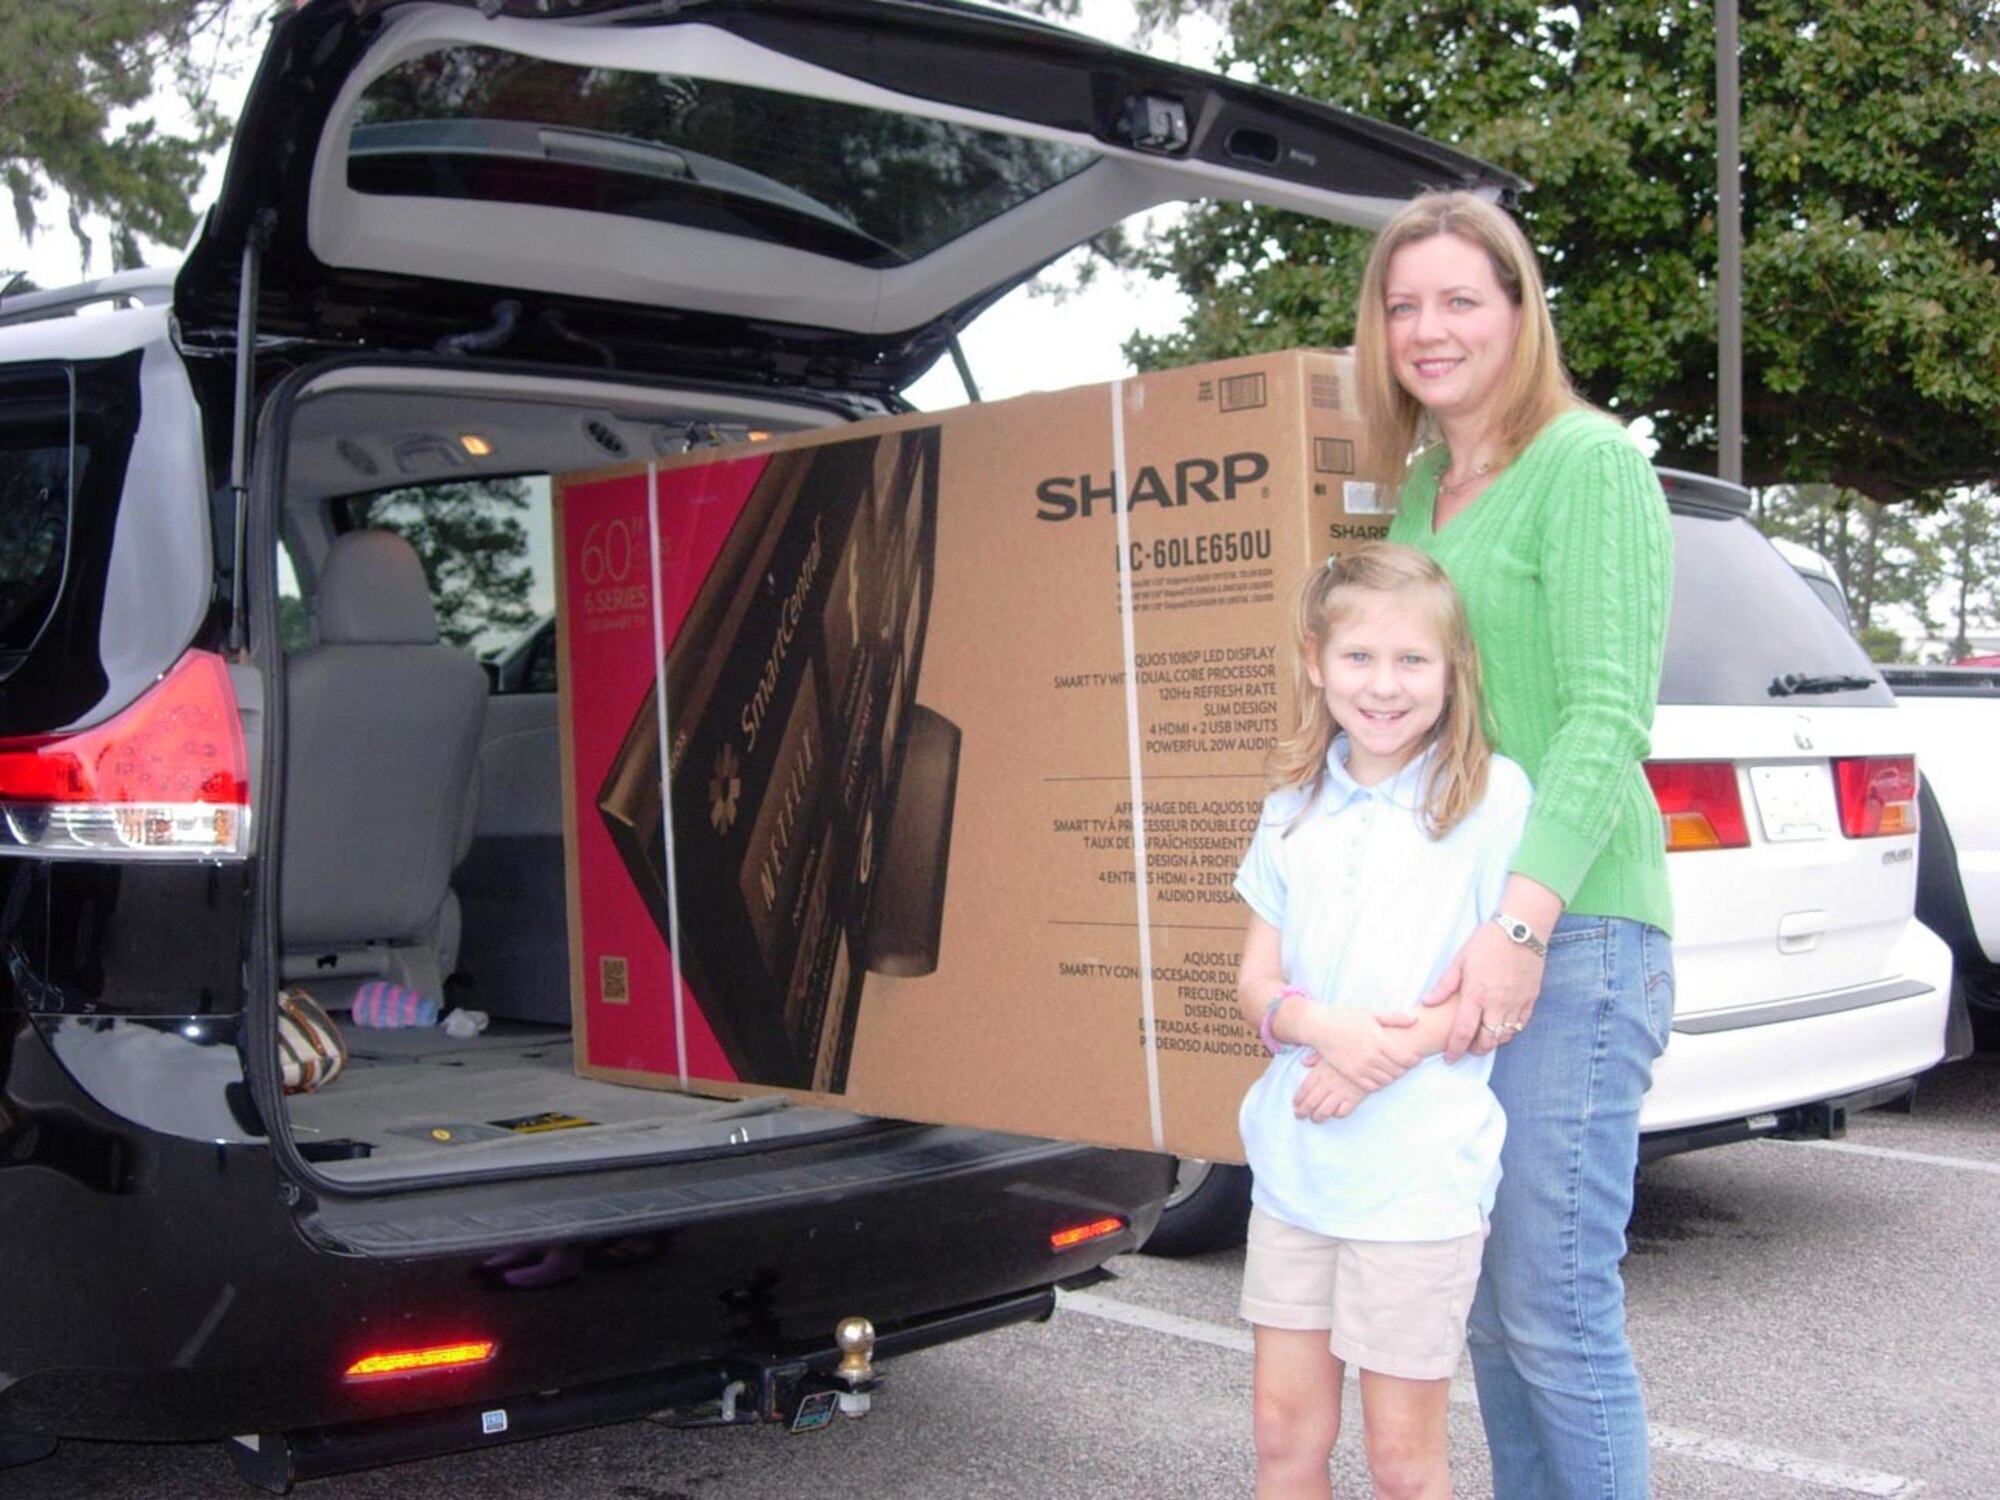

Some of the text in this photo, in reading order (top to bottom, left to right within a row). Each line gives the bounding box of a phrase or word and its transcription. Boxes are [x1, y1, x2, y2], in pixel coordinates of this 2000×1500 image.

[1036, 452, 1270, 521] SHARP
[1330, 523, 1389, 540] SHARP
[741, 514, 823, 752] SmartCentral
[1169, 650, 1201, 664] 1080P
[1203, 649, 1224, 663] LED
[1227, 646, 1276, 662] DISPLAY
[1054, 674, 1090, 688] SMART
[1093, 673, 1108, 687] TV
[1141, 669, 1172, 685] DUAL
[1174, 667, 1205, 682] CORE
[1208, 665, 1276, 680] PROCESSOR
[1159, 683, 1277, 700] 120Hz REFRESH RATE
[1204, 701, 1277, 717] SLIM DESIGN
[1150, 724, 1156, 735] 4
[1159, 722, 1189, 735] HDMI
[1200, 721, 1207, 734] 2
[1209, 720, 1232, 734] USB
[1234, 719, 1278, 732] INPUTS
[1146, 737, 1279, 753] POWERFUL 20W AUDIO
[1179, 801, 1200, 814] DEL
[1202, 801, 1244, 815] AQUOS
[760, 732, 816, 912] NETFLIX
[1054, 819, 1092, 832] SMART
[1093, 819, 1107, 832] TV
[1118, 819, 1189, 832] PRCESSEUR
[1190, 818, 1238, 832] DOUBLE
[1239, 819, 1260, 832] CO
[1084, 836, 1114, 849] TAUX
[1116, 836, 1131, 849] DE
[1147, 854, 1189, 867] DESIGN
[1201, 854, 1241, 867] PROFIL
[1098, 872, 1105, 883] 4
[1156, 872, 1188, 885] HDMI
[1198, 872, 1205, 885] 2
[1157, 889, 1196, 903] AUDIO
[1183, 953, 1225, 967] AQUOS
[1059, 963, 1097, 976] SMART
[1098, 964, 1113, 977] TV
[1114, 965, 1138, 979] CON
[1178, 986, 1239, 1002] FRECUENC
[1184, 1002, 1228, 1019] DISEÑO
[1138, 1017, 1201, 1034] ETRADAS:
[1203, 1024, 1210, 1034] 4
[1212, 1023, 1244, 1038] HDMI
[1139, 1036, 1201, 1053] PDEROSO
[1203, 1040, 1243, 1055] AUDIO
[1244, 1043, 1260, 1058] DE
